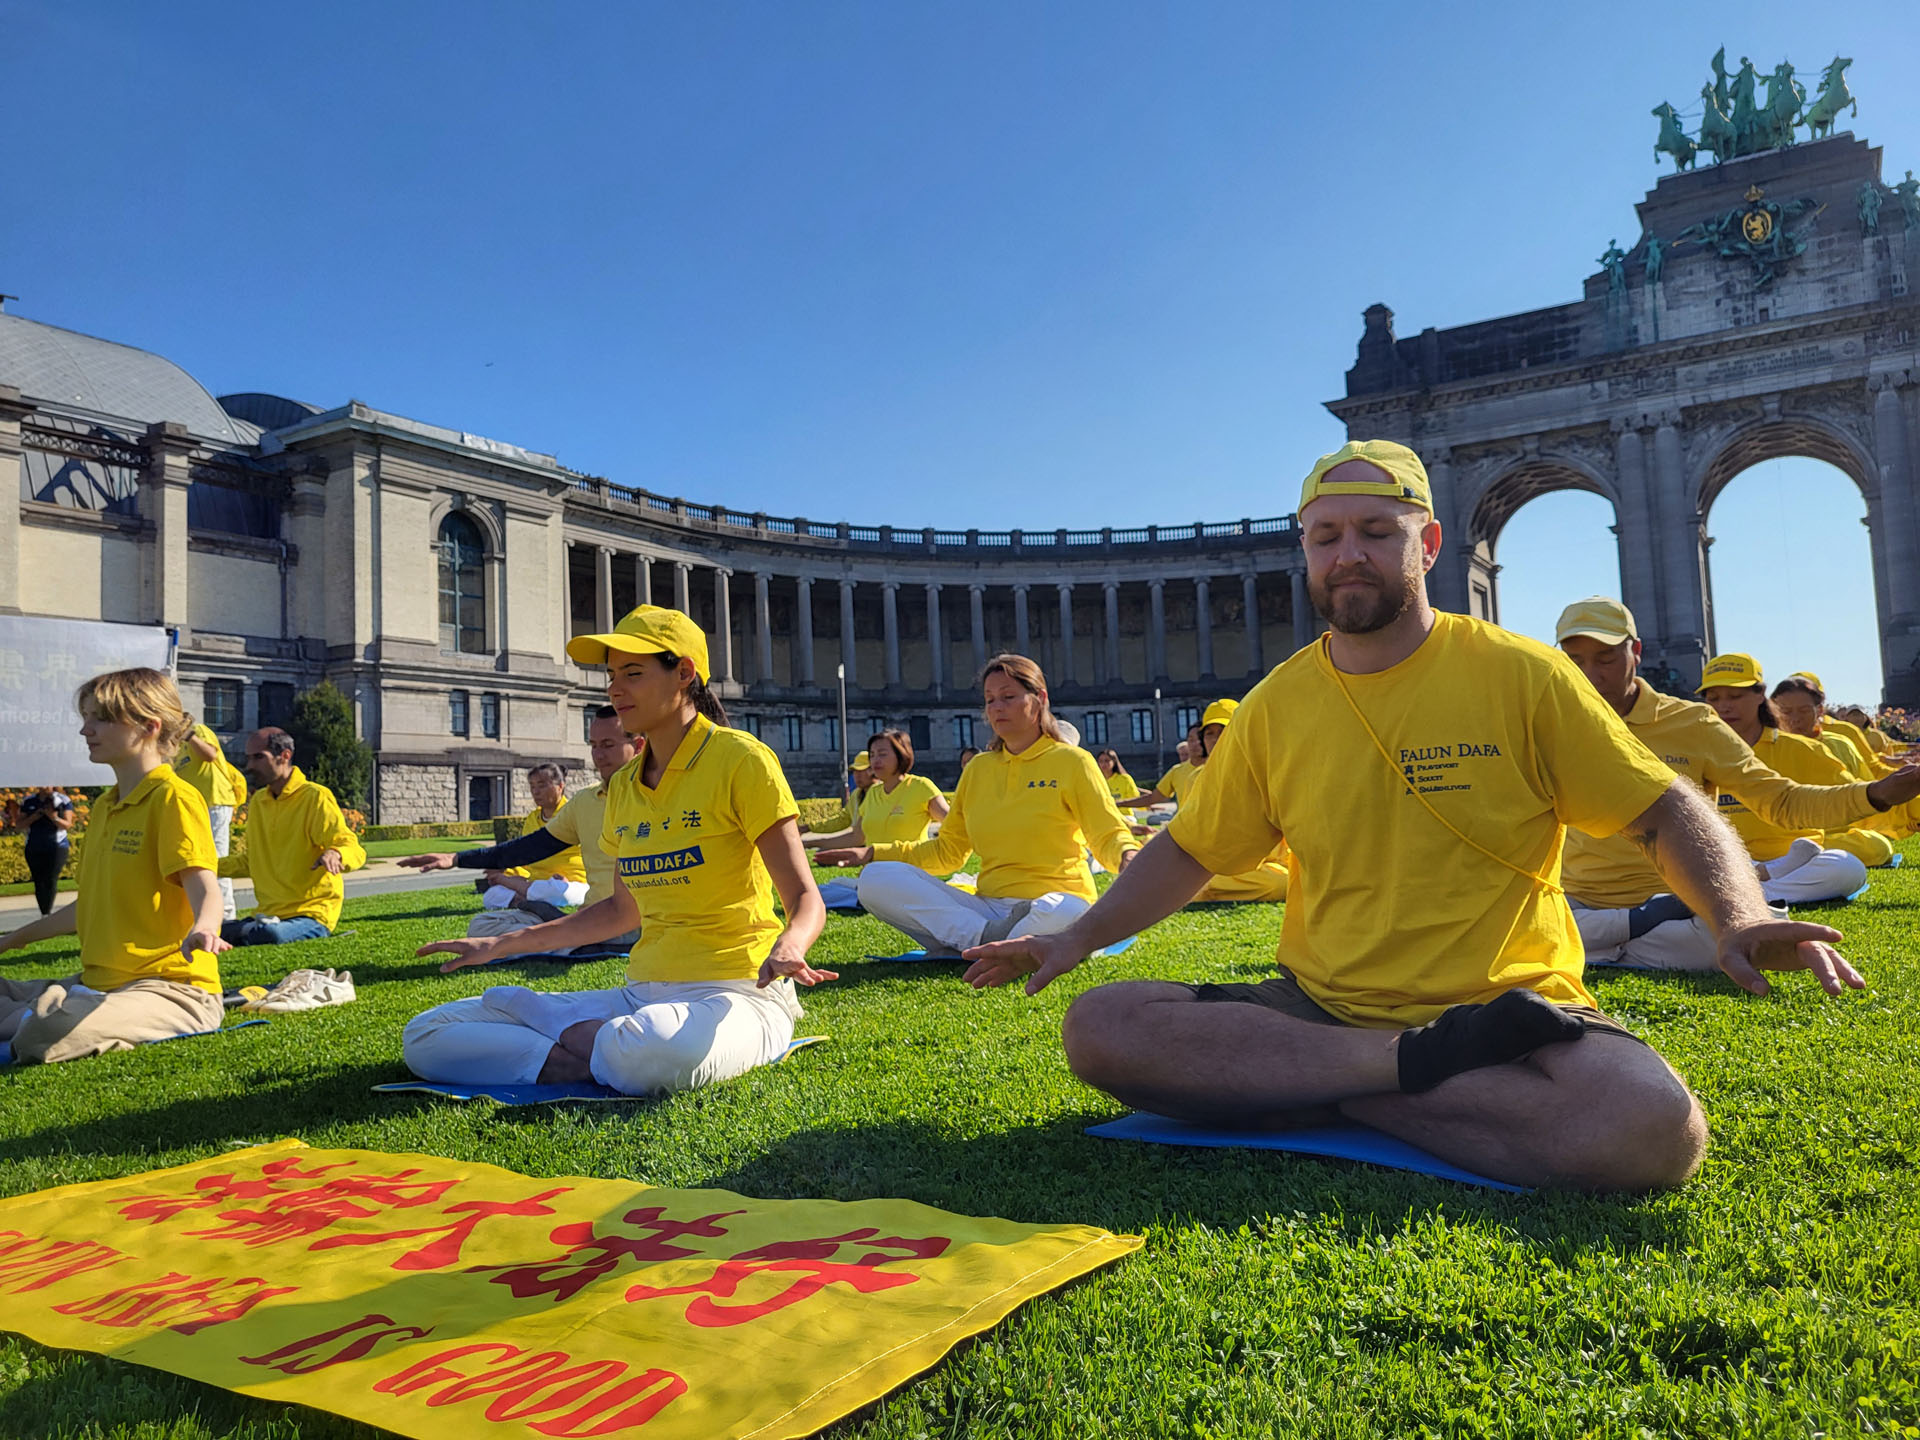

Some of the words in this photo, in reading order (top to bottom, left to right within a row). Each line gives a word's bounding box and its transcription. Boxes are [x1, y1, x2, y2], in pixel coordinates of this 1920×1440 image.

[1400, 746, 1452, 763] FALUN
[1457, 743, 1501, 757] DAFA
[1665, 755, 1689, 765] DAFA
[620, 859, 650, 874] ALUN
[655, 852, 697, 870] DAFA
[237, 1313, 437, 1375] IS
[372, 1342, 690, 1439] GOOD
